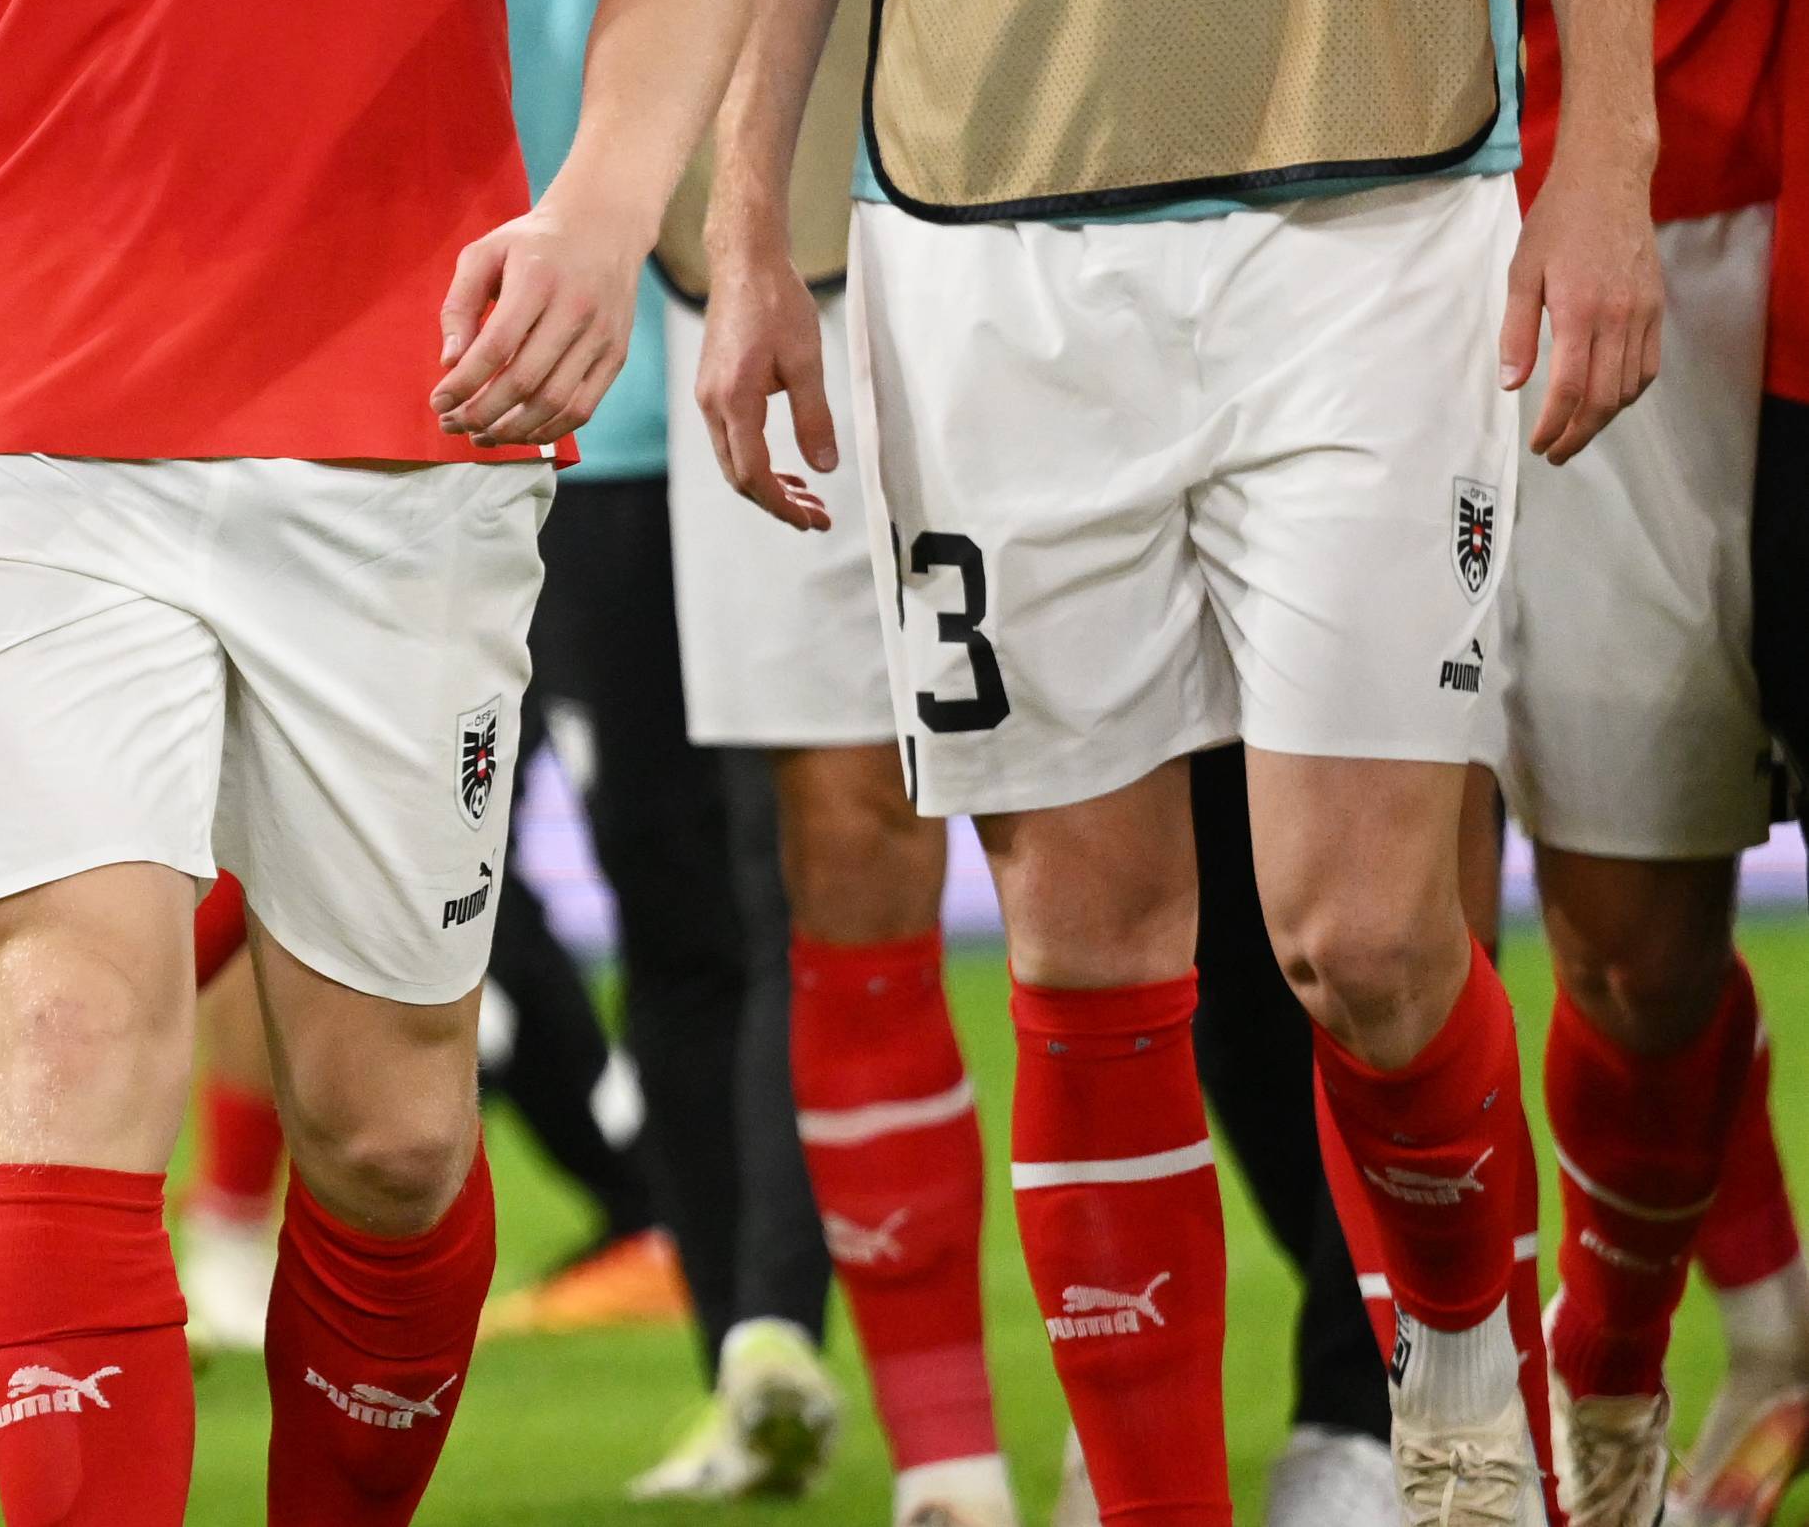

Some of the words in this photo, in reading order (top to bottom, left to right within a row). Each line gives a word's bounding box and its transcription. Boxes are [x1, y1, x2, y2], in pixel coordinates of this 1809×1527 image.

[890, 521, 1011, 733] 3
[1439, 660, 1481, 693] PUMA
[441, 883, 490, 930] PUMA
[304, 1367, 413, 1429] PUMA
